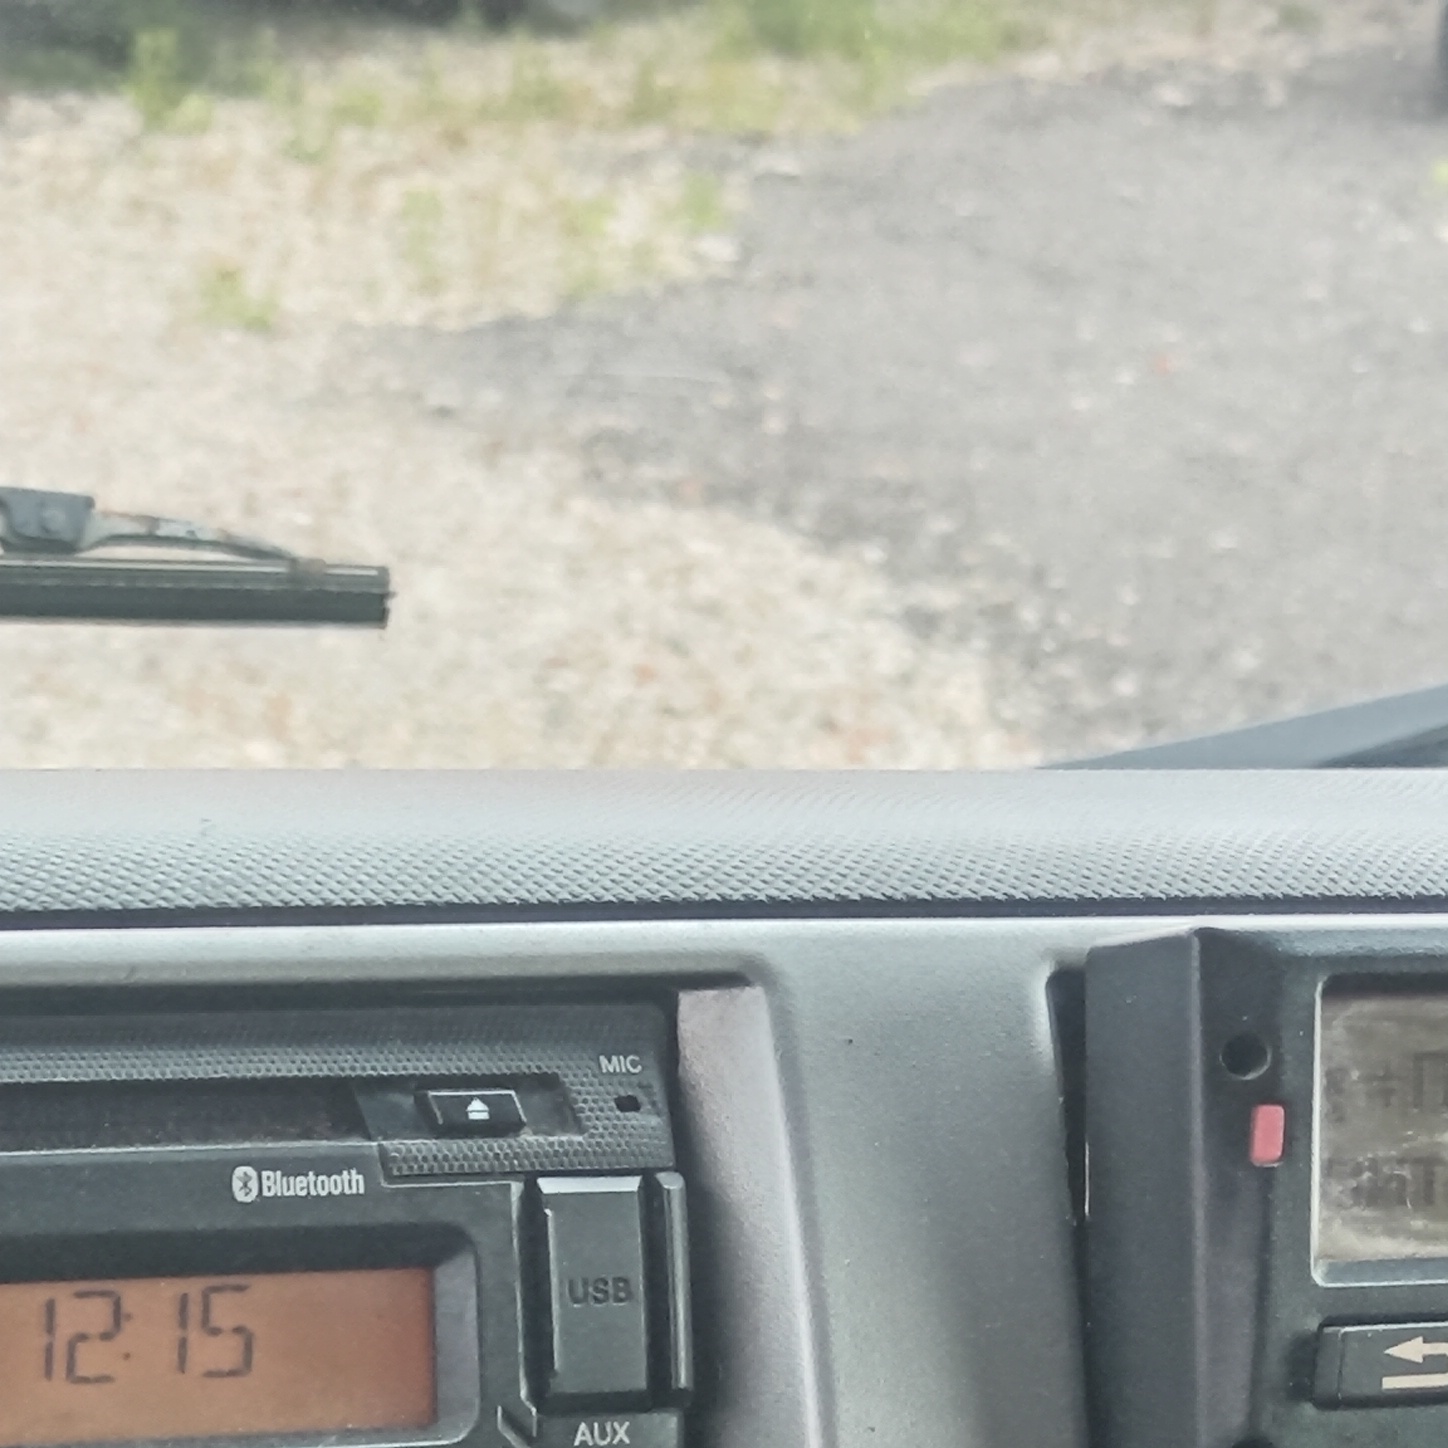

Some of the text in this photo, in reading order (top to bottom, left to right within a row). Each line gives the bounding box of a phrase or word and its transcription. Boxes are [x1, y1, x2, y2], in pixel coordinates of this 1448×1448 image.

[600, 1055, 642, 1075] MIC
[261, 1169, 365, 1198] Bluetooth
[567, 1276, 633, 1307] USB
[44, 1284, 256, 1385] 12:15
[573, 1421, 630, 1447] AUX
